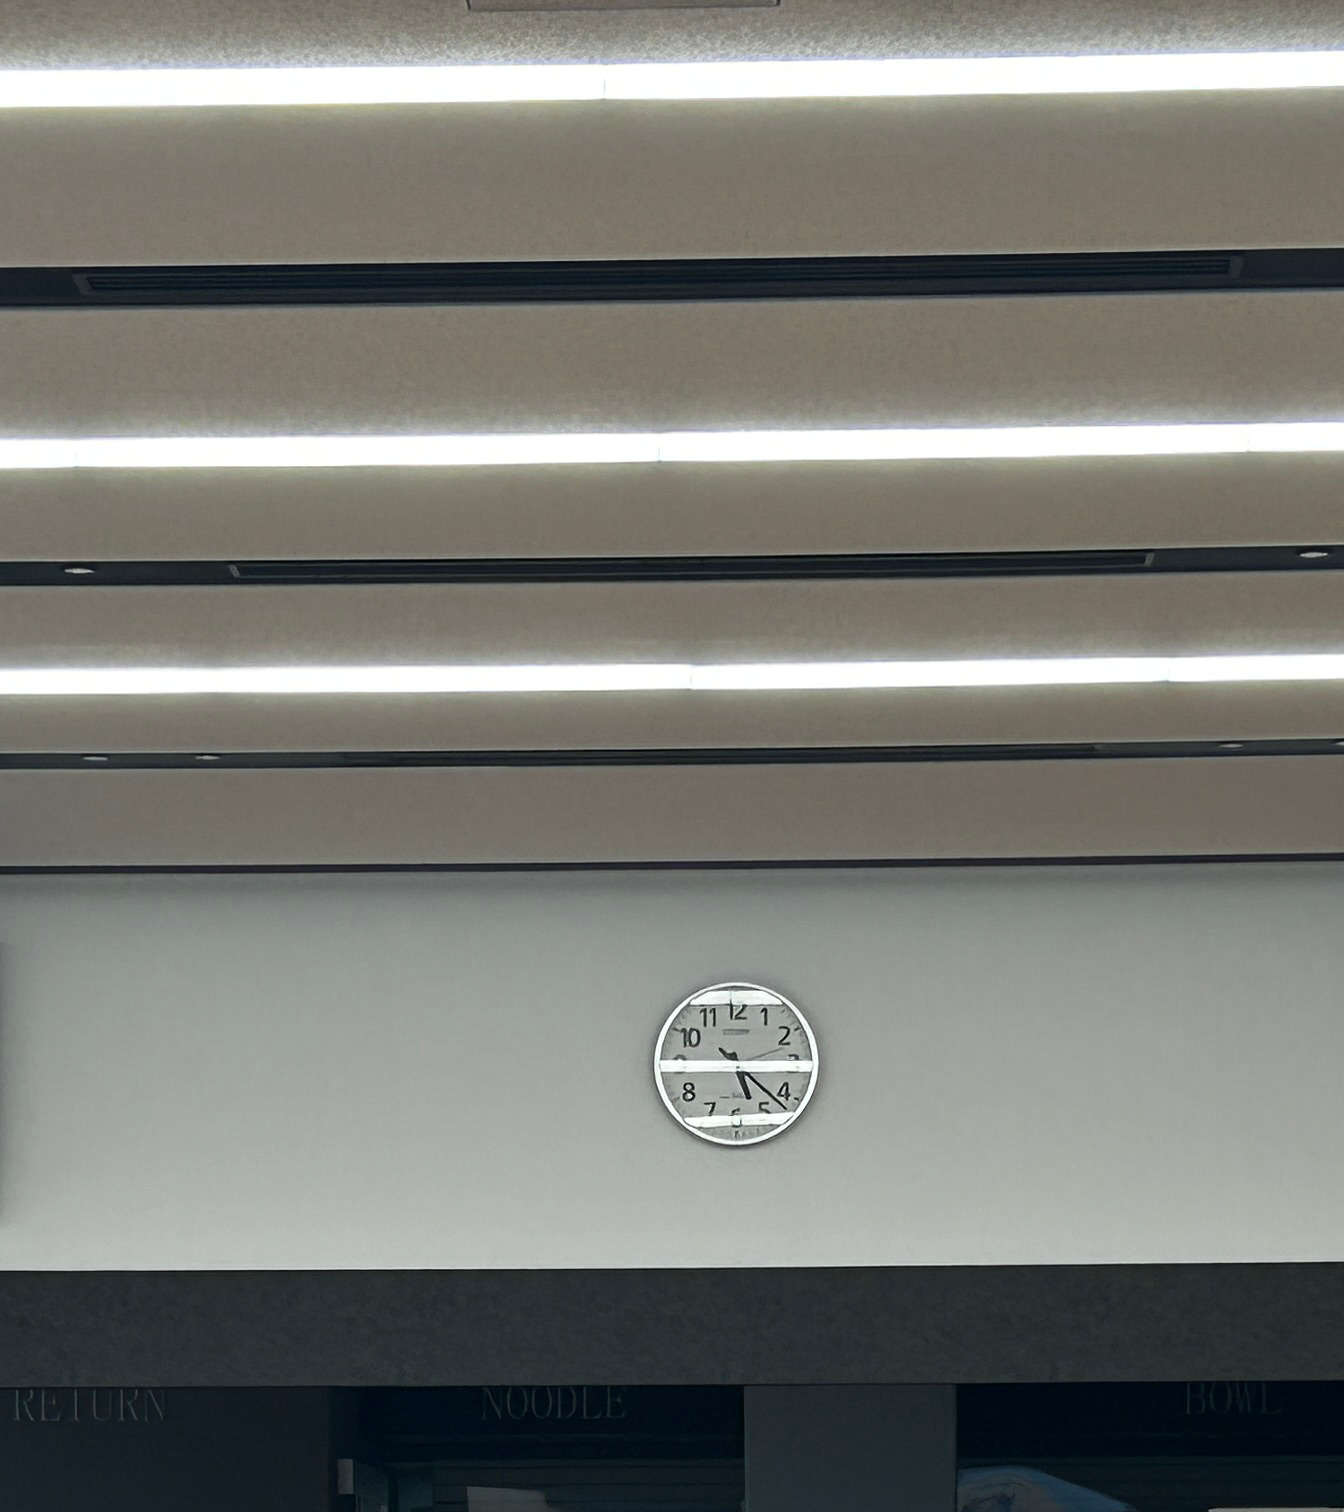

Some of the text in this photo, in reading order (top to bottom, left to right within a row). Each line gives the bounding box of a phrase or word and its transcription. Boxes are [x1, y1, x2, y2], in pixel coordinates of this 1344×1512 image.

[700, 1007, 717, 1027] 11
[760, 1007, 768, 1026] 1
[680, 1028, 701, 1047] 10
[778, 1026, 791, 1045] 2
[682, 1082, 696, 1101] 8
[777, 1081, 791, 1101] 4
[13, 1388, 166, 1422] RETURN
[480, 1385, 627, 1420] NOODLE
[1184, 1382, 1282, 1415] BOWL
